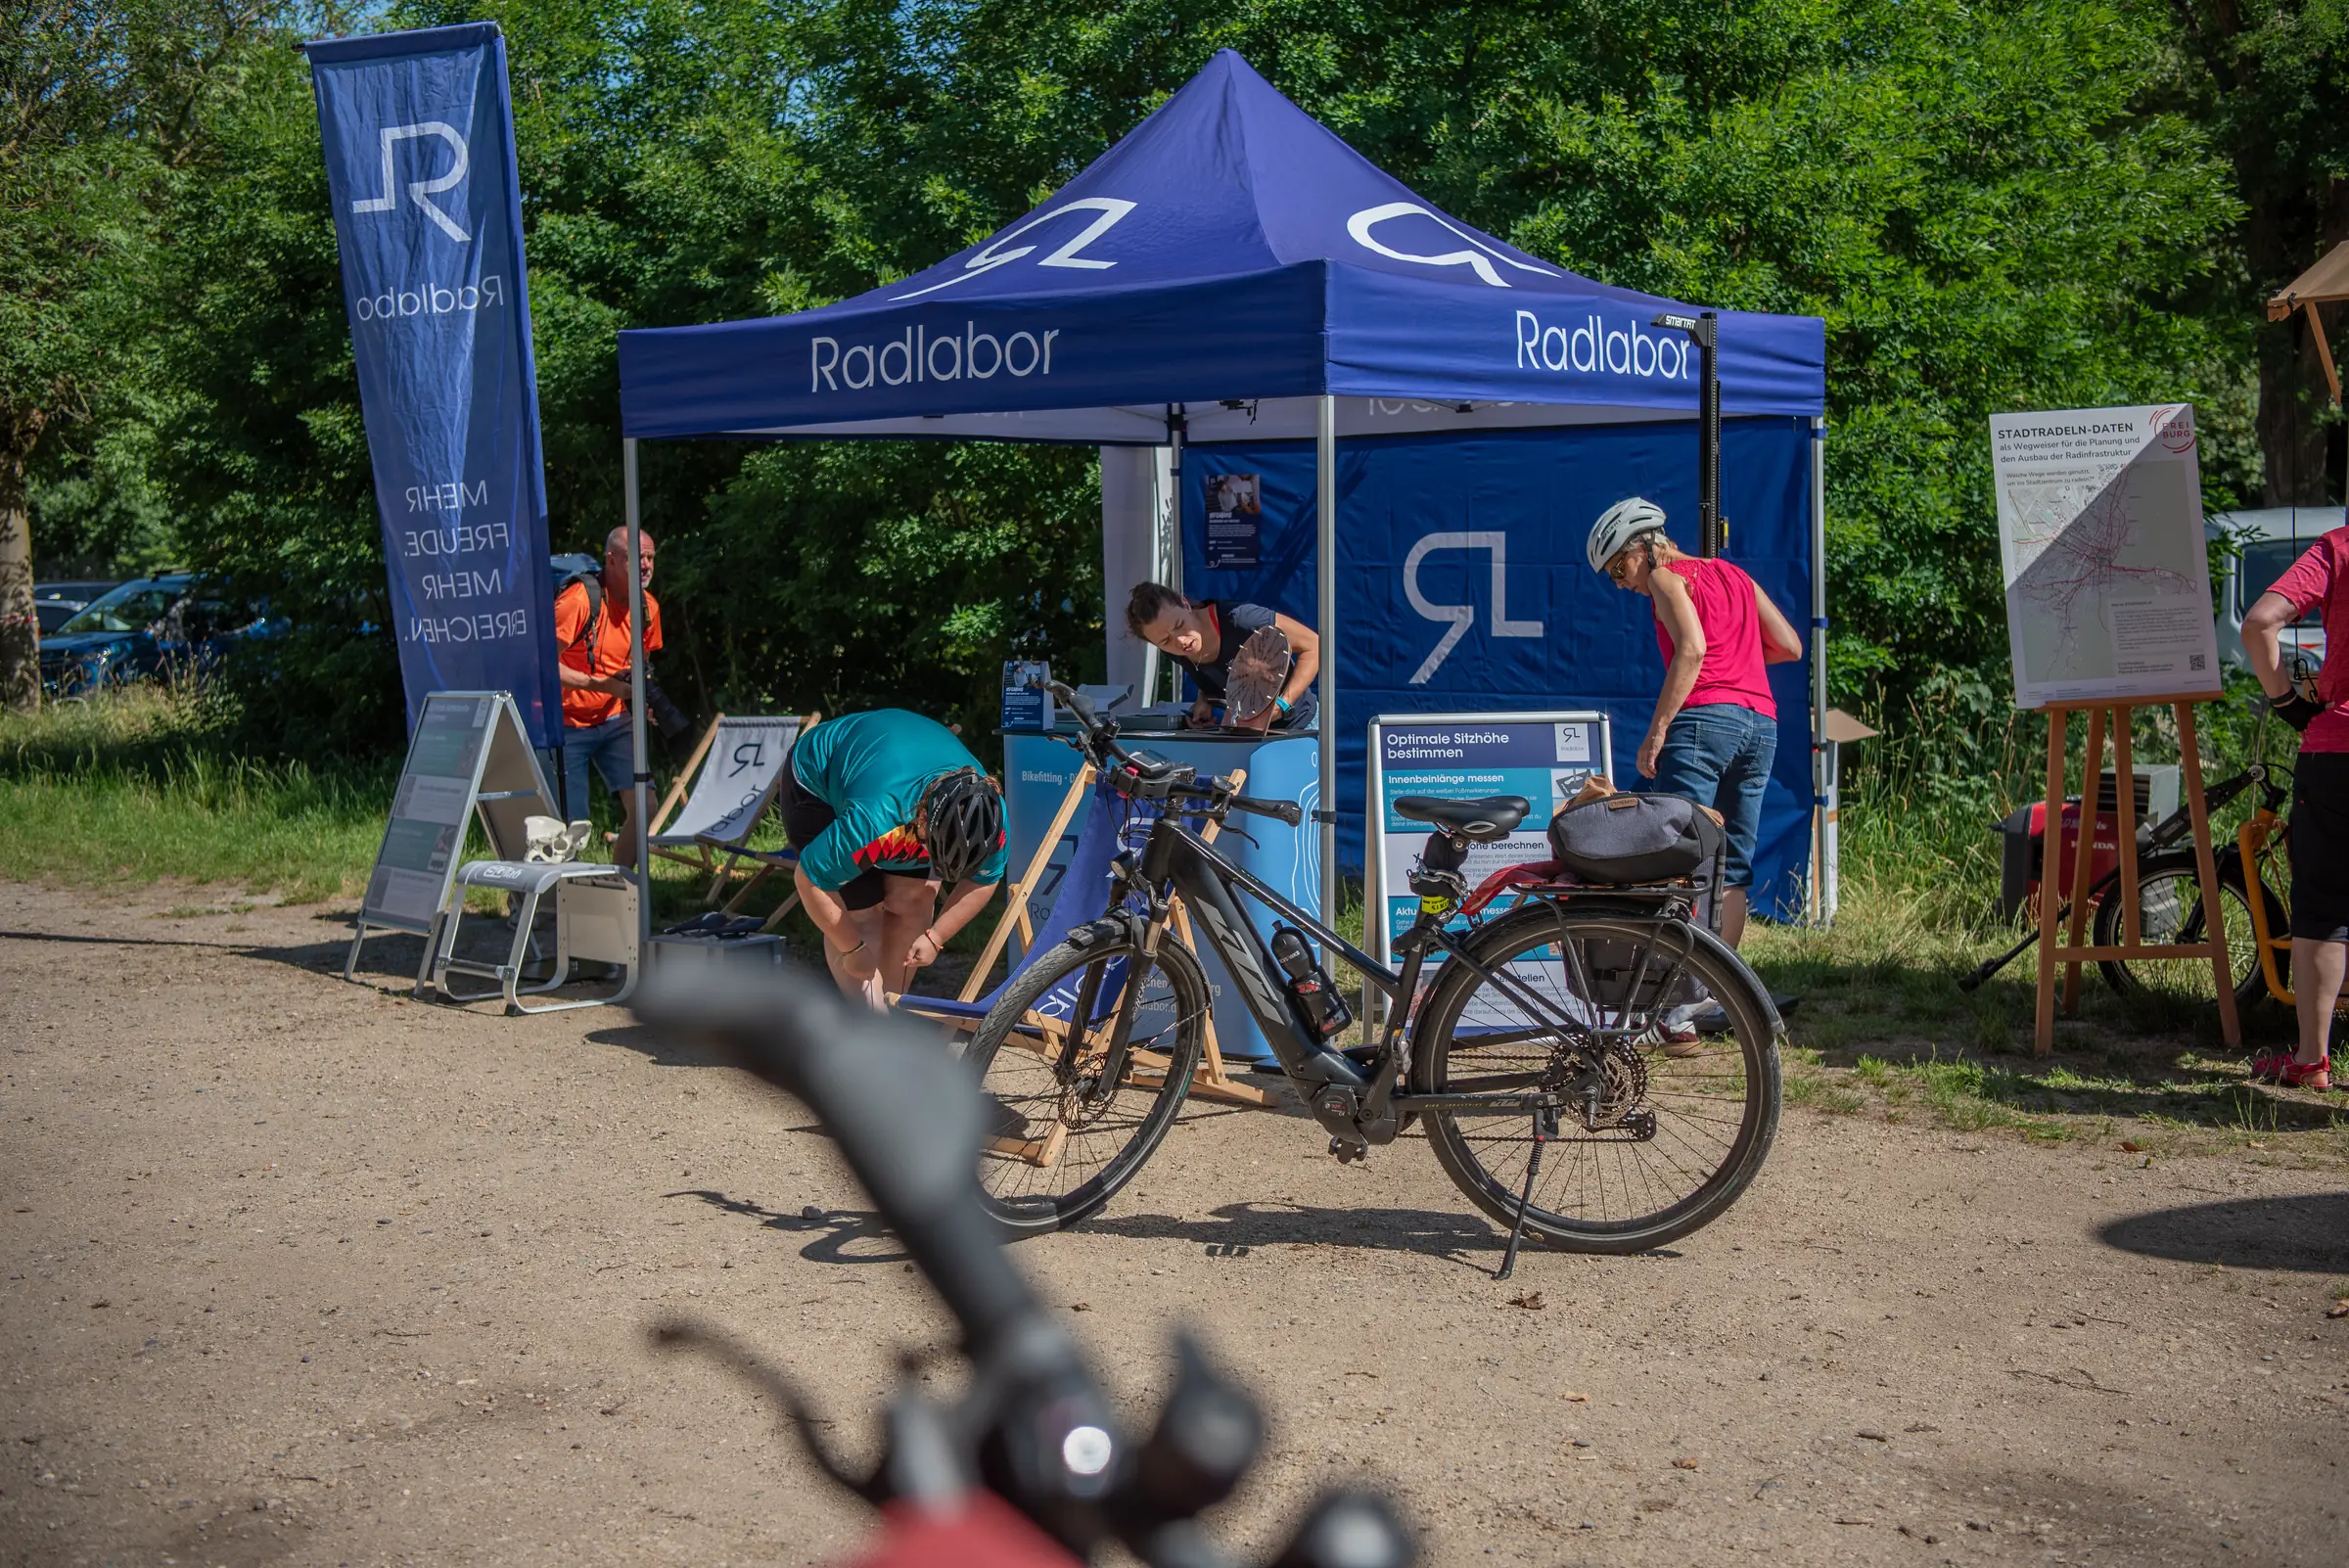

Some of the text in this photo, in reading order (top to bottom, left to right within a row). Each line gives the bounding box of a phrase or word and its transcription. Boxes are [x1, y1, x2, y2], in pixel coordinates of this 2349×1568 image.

[1516, 309, 1691, 380] Radlabor
[811, 320, 1060, 392] Radlabor
[1998, 423, 2134, 439] STADTRADELN-DATEN
[2162, 421, 2189, 431] FREI
[2162, 430, 2190, 438] BURG
[2013, 440, 2059, 451] Wegweiser
[2089, 438, 2123, 446] Planung
[2017, 453, 2049, 462] Ausbau
[2065, 449, 2132, 459] Radinfrastruktur
[1387, 732, 1509, 747] Optimale Sitzhöhe
[1387, 747, 1463, 759] bestimmen
[1022, 771, 1062, 785] Bikefitting
[1388, 774, 1465, 784] Innenbeinlänge
[1396, 906, 1417, 916] Aktu
